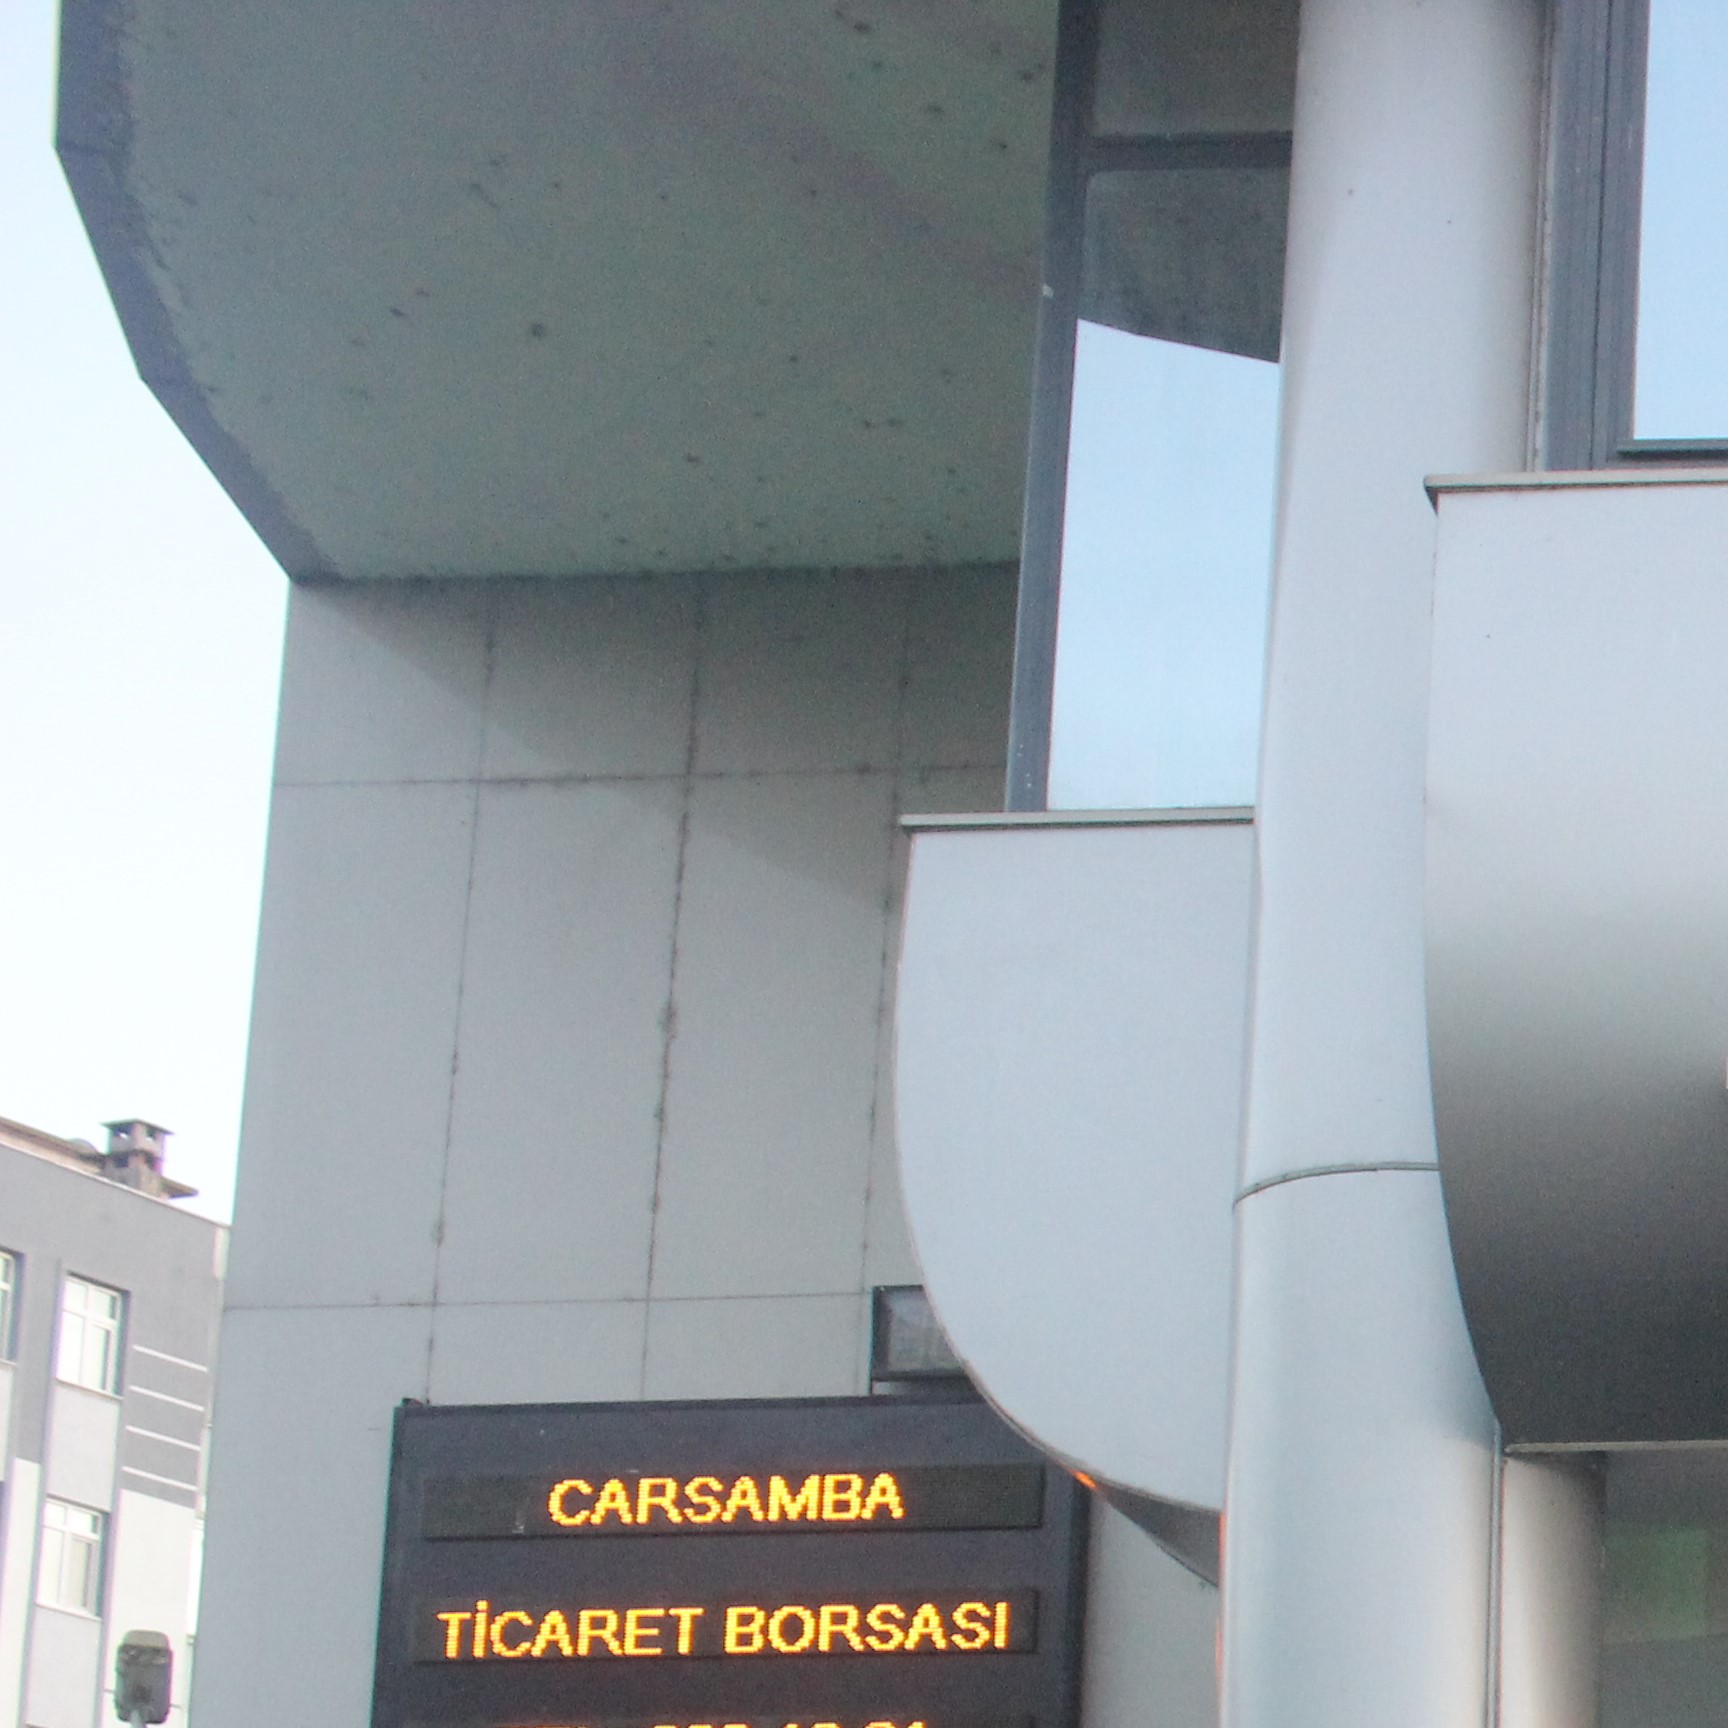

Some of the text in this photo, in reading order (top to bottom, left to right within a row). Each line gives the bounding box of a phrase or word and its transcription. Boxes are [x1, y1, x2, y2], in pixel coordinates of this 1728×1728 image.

[549, 1473, 904, 1526] CARSAMBA
[437, 1600, 1009, 1658] TİCARET BORSASI
